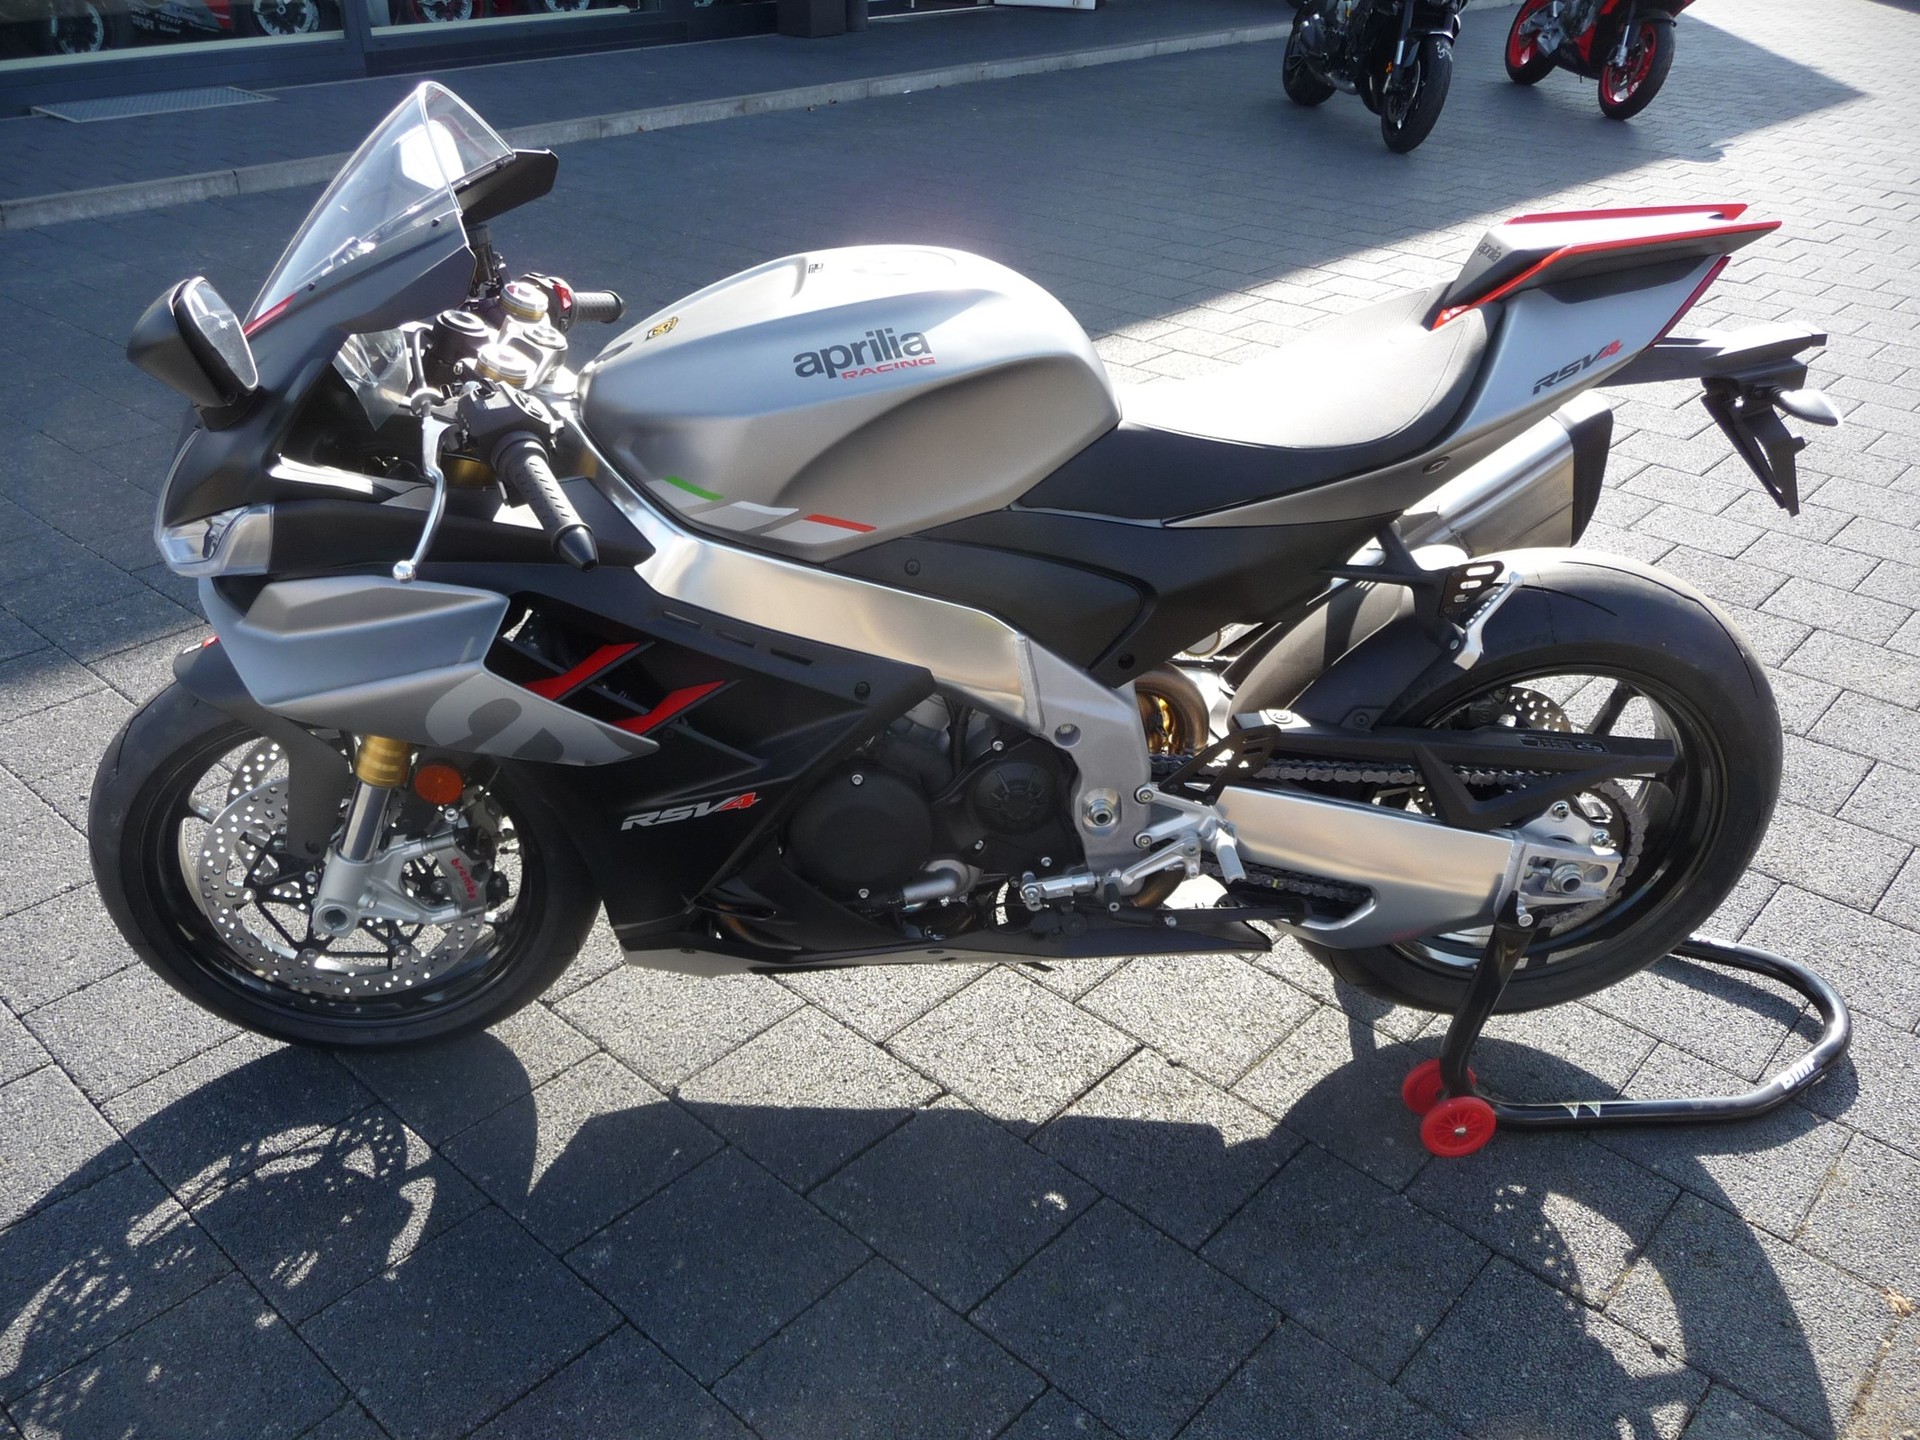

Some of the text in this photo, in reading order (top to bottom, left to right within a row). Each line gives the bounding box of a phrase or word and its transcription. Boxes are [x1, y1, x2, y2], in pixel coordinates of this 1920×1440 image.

[793, 327, 932, 379] aprilia
[841, 356, 936, 380] RACING
[1532, 339, 1623, 396] RSV4
[620, 791, 762, 831] RSV4
[451, 856, 478, 900] brembo
